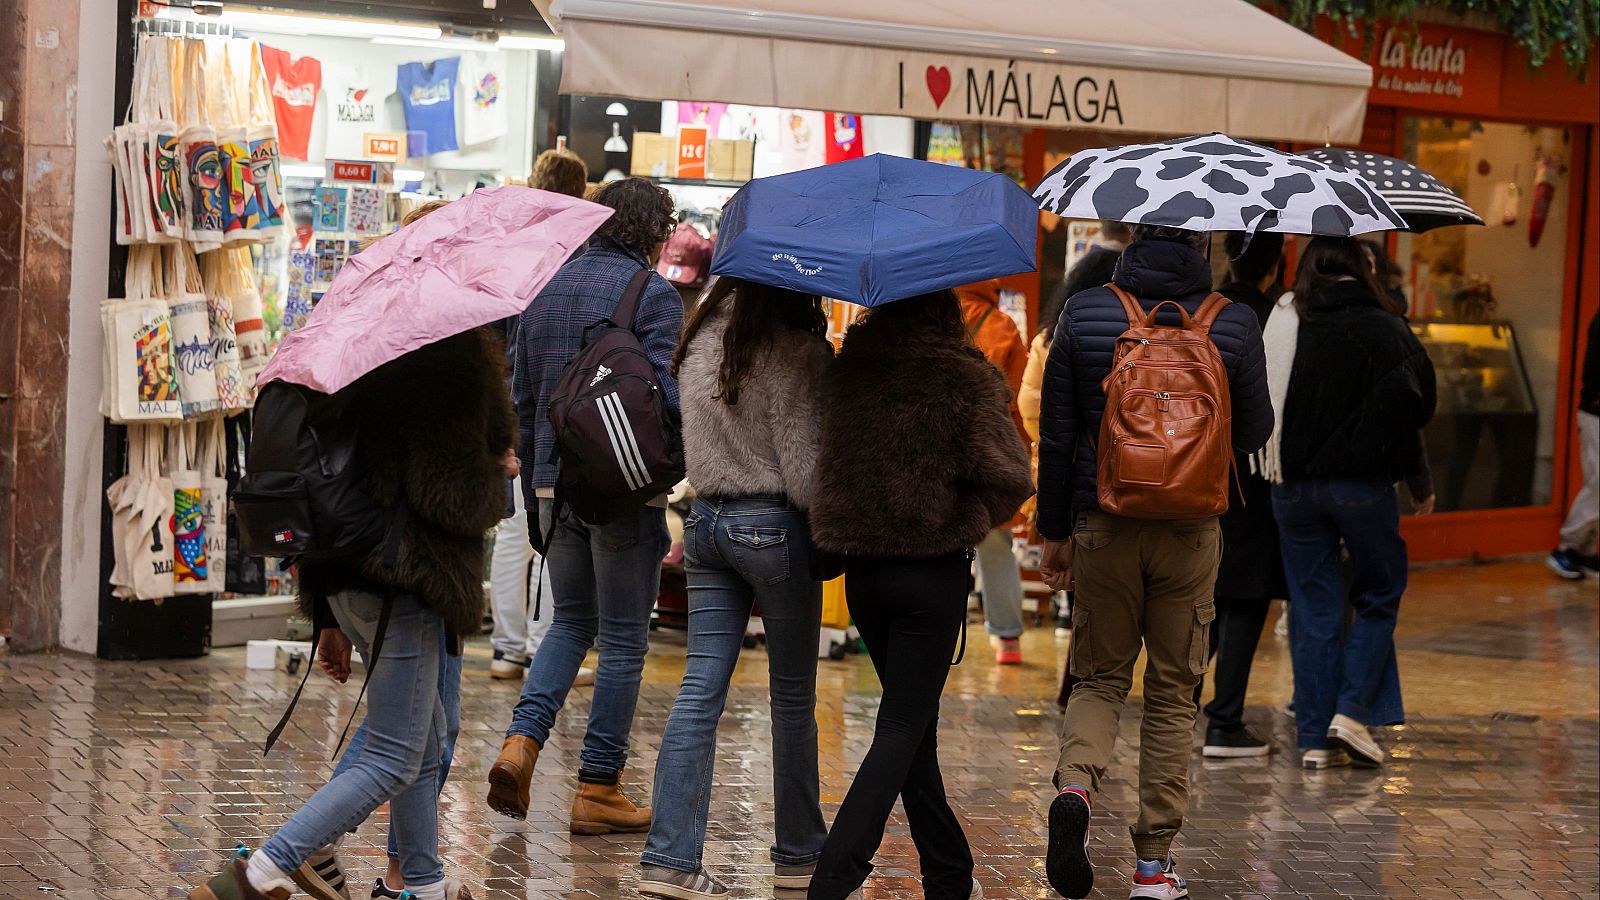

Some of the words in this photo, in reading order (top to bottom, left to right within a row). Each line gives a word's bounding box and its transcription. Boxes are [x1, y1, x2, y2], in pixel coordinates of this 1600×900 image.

[899, 62, 904, 109] I
[967, 59, 1123, 125] MÁLAGA
[339, 166, 359, 177] 0,60
[772, 253, 783, 261] go
[783, 253, 798, 265] with
[795, 263, 805, 274] the
[804, 265, 823, 276] flow
